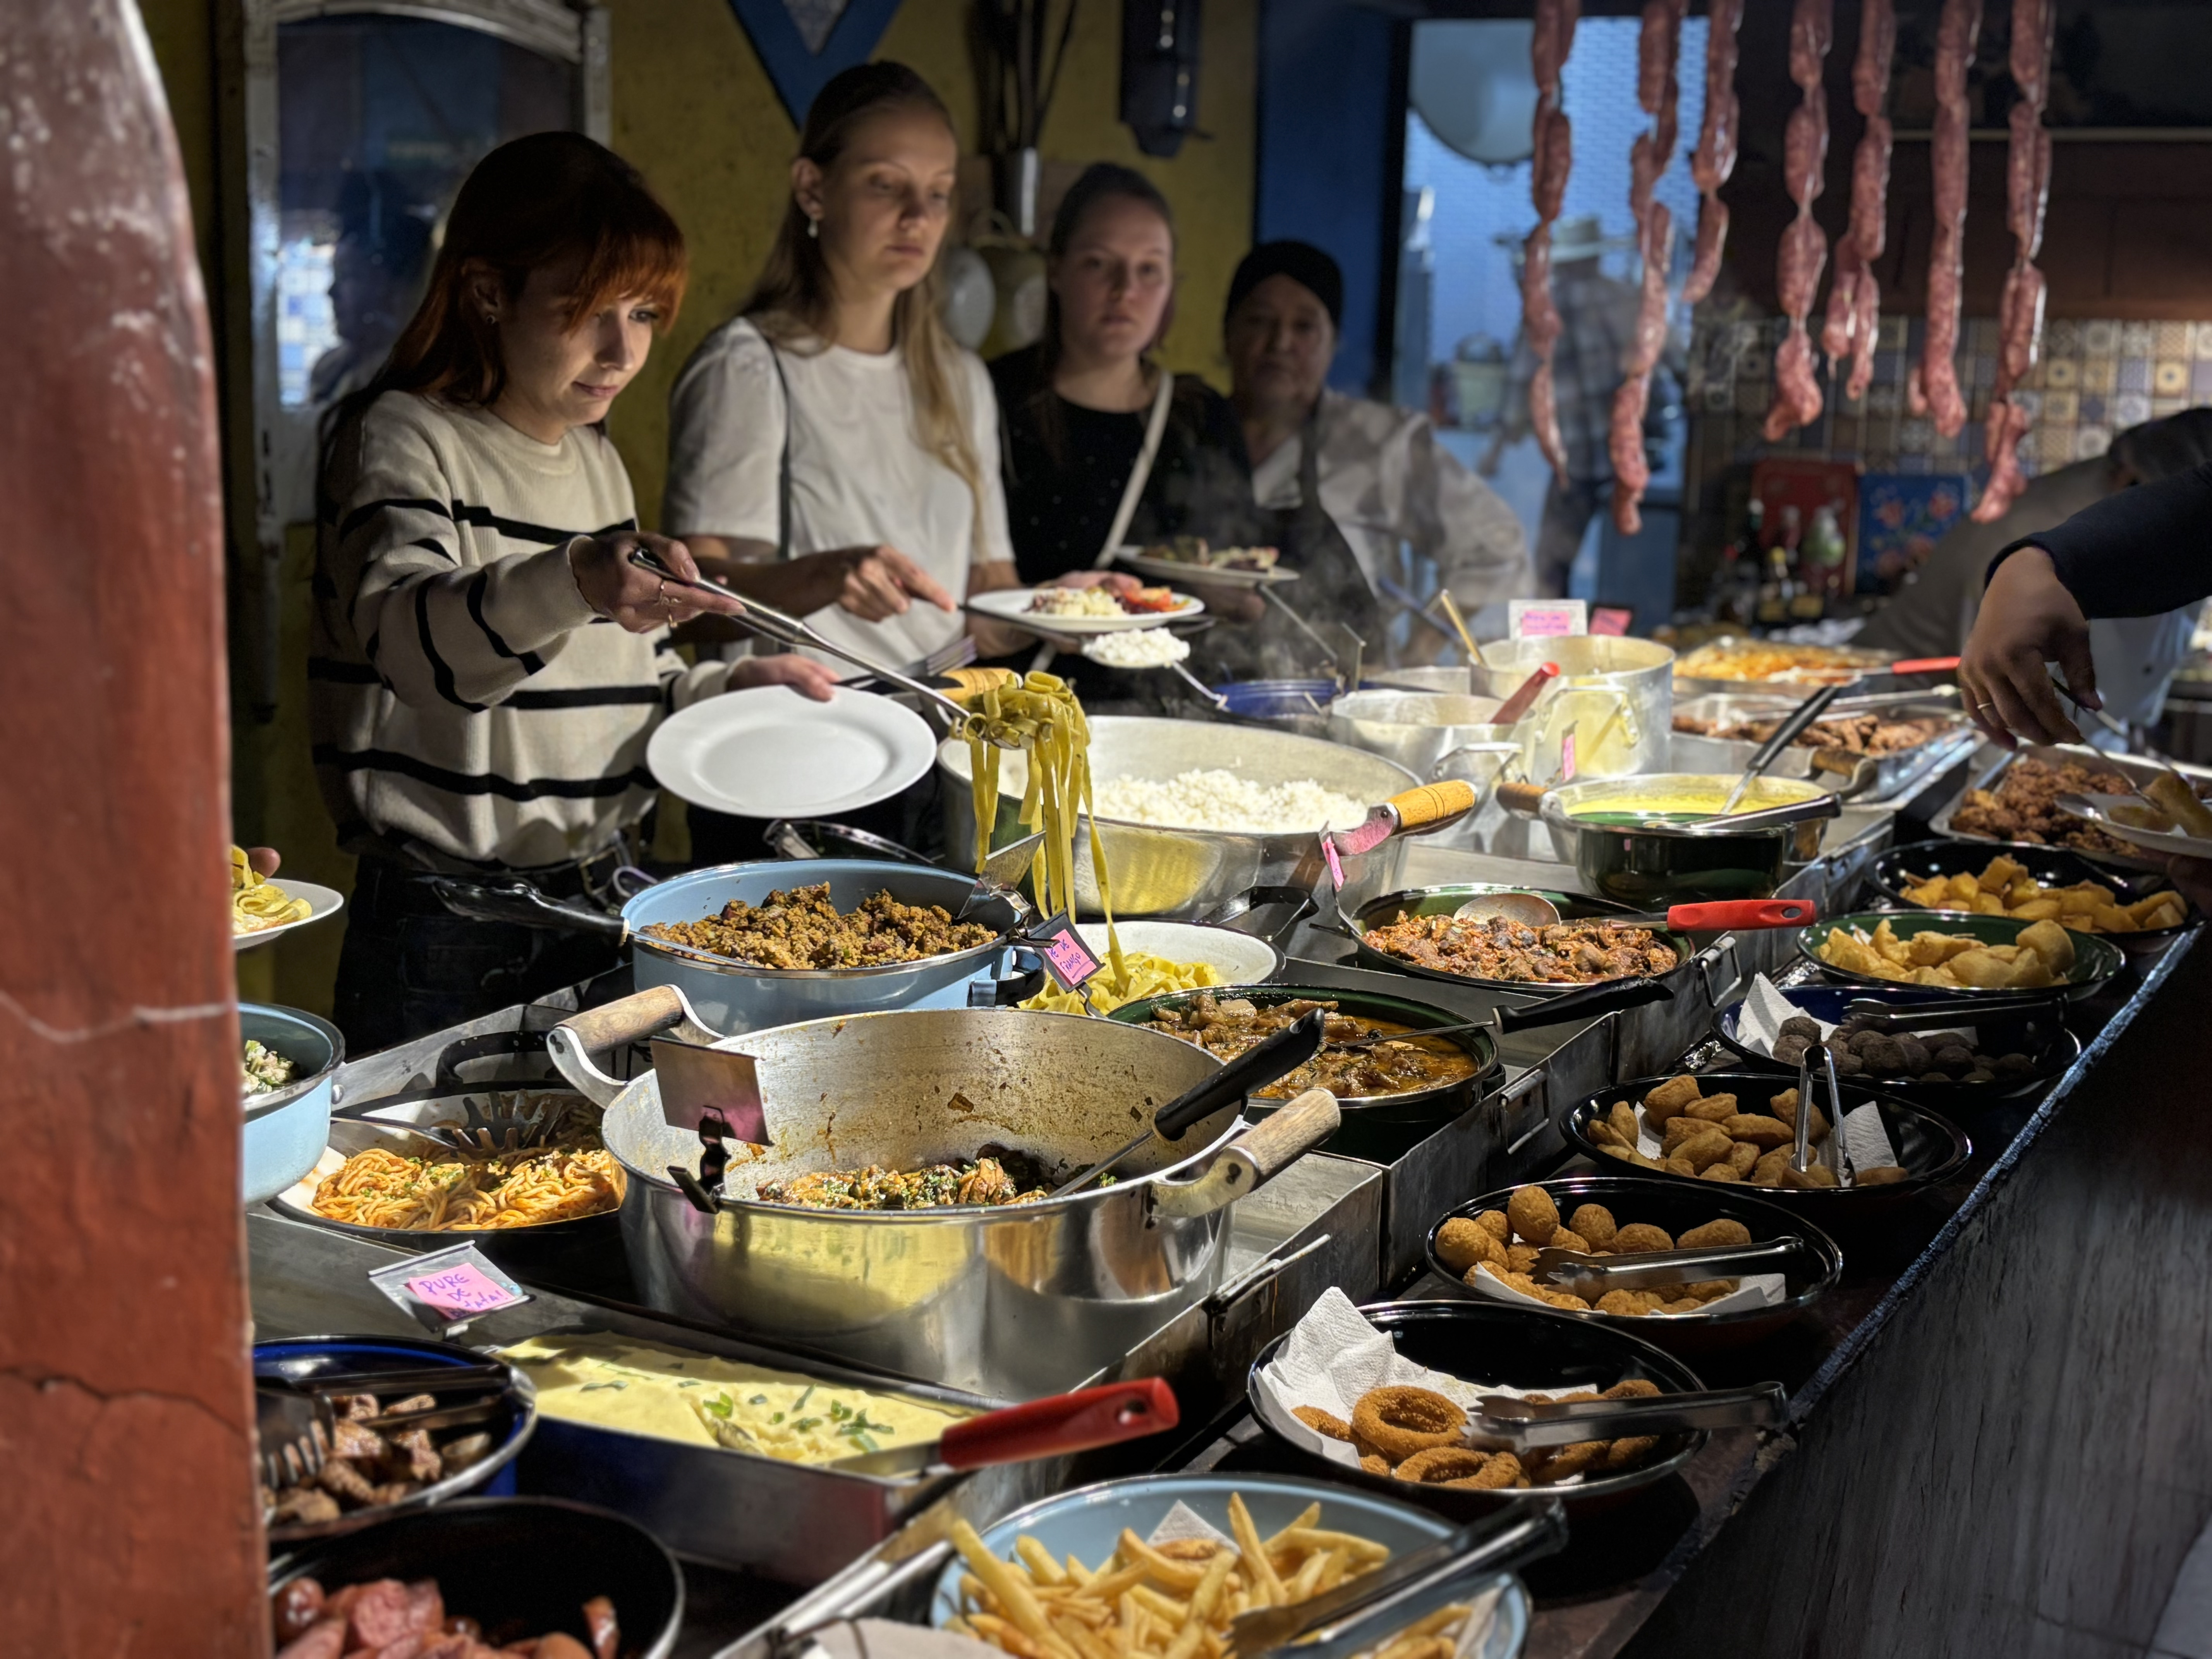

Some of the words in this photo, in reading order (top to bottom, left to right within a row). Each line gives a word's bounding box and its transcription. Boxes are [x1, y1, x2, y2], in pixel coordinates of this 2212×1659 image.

[1060, 952, 1081, 974] FRANGO
[419, 1274, 470, 1295] PURE
[447, 1288, 471, 1302] DE
